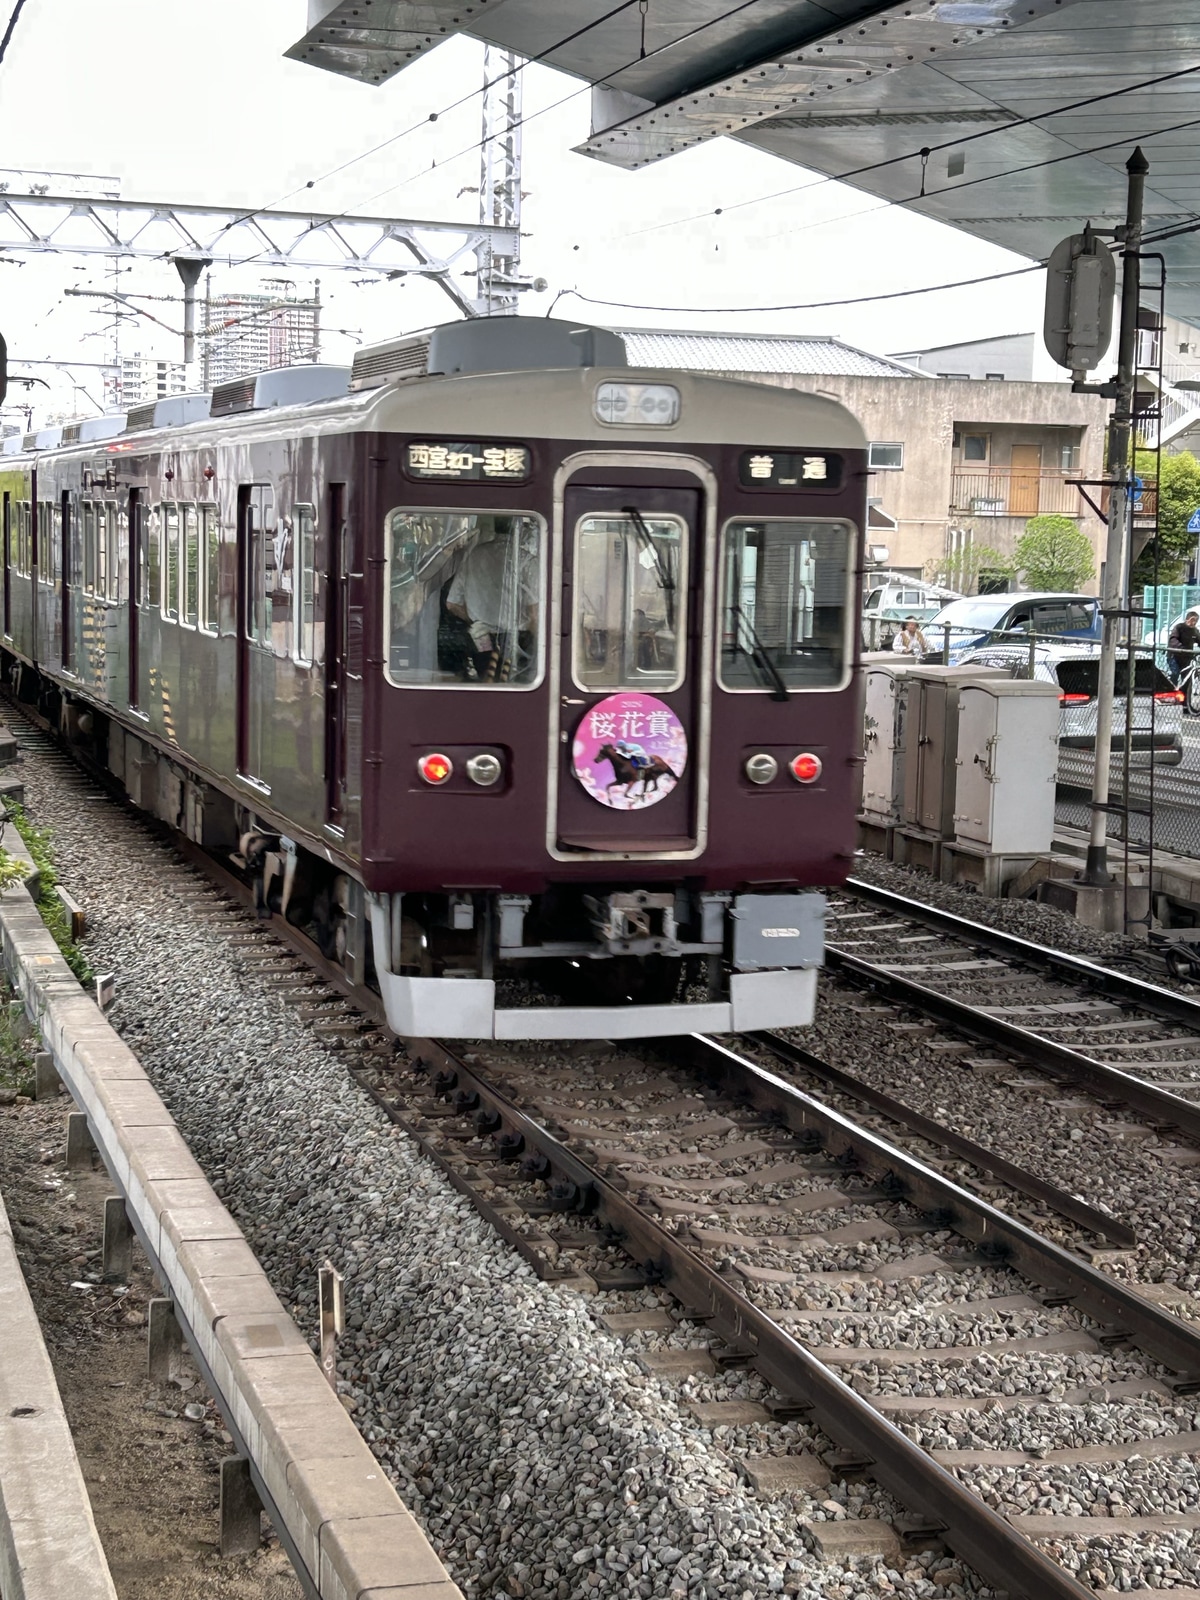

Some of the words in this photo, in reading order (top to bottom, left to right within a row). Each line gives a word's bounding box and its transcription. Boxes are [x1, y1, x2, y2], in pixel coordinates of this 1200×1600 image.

[749, 456, 827, 479] 普通
[589, 711, 673, 739] 桜花賞
